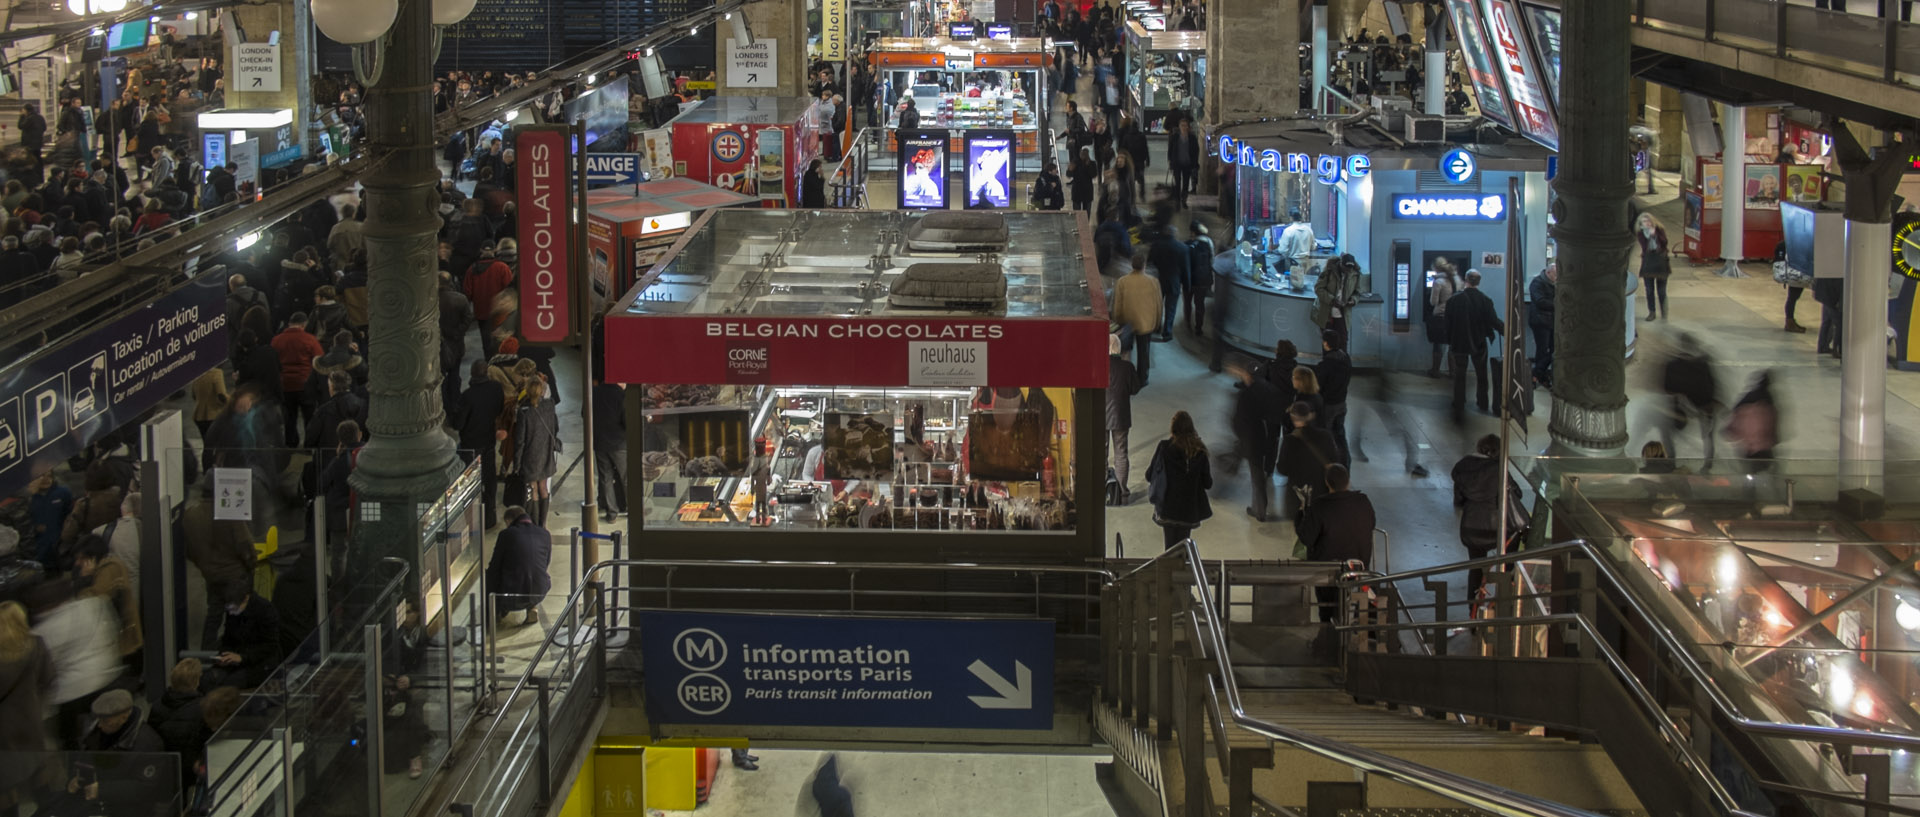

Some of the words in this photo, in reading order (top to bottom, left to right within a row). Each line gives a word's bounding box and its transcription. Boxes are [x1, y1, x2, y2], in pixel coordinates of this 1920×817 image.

[828, 0, 839, 57] bonbons
[746, 60, 768, 68] ÉTAGE
[573, 157, 635, 172] ANGE
[1219, 134, 1371, 185] Change
[532, 143, 555, 331] CHOCOLATES
[112, 333, 142, 361] Taxis
[158, 305, 199, 337] Parking
[706, 323, 818, 337] BELGIAN
[828, 324, 1004, 338] CHOCOLATES
[112, 349, 163, 387] Location
[166, 337, 181, 356] de
[184, 313, 226, 346] voitures
[920, 343, 976, 363] neuhaus
[113, 389, 125, 404] Car
[126, 379, 145, 397] rental
[151, 350, 196, 382] Autovermietung
[36, 389, 57, 440] P
[685, 638, 715, 662] M
[743, 643, 910, 665] information
[743, 666, 853, 684] transports
[860, 667, 912, 681] Paris
[684, 685, 724, 702] RER
[745, 687, 783, 699] Paris
[787, 688, 837, 700] transit
[841, 688, 932, 700] information
